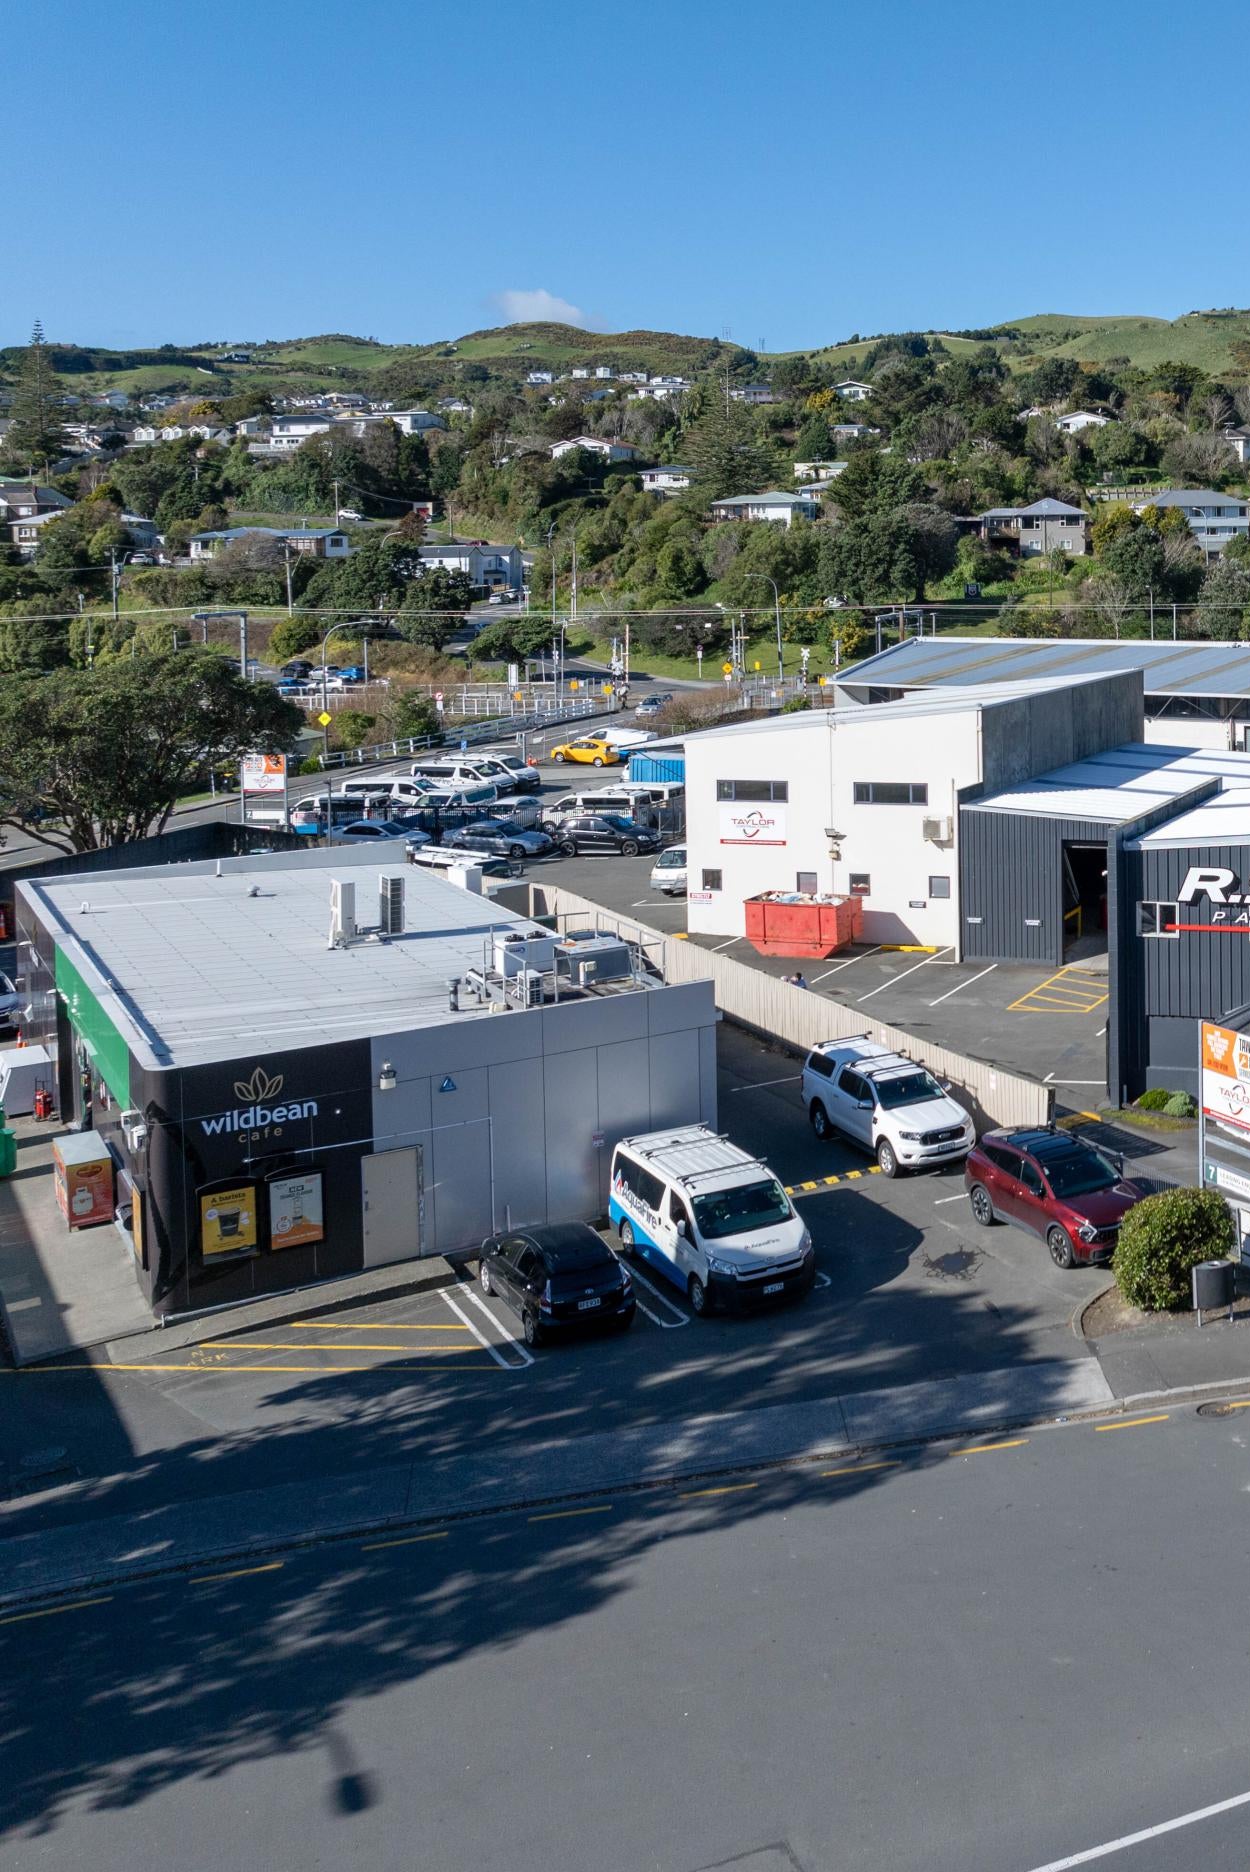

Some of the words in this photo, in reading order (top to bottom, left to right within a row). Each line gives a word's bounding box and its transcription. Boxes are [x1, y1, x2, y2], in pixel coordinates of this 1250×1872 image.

[731, 818, 775, 826] TAYLOR
[201, 1100, 318, 1136] wildbean
[238, 1126, 283, 1144] cafe
[1208, 1165, 1216, 1179] 7
[621, 1180, 657, 1229] AquaFire
